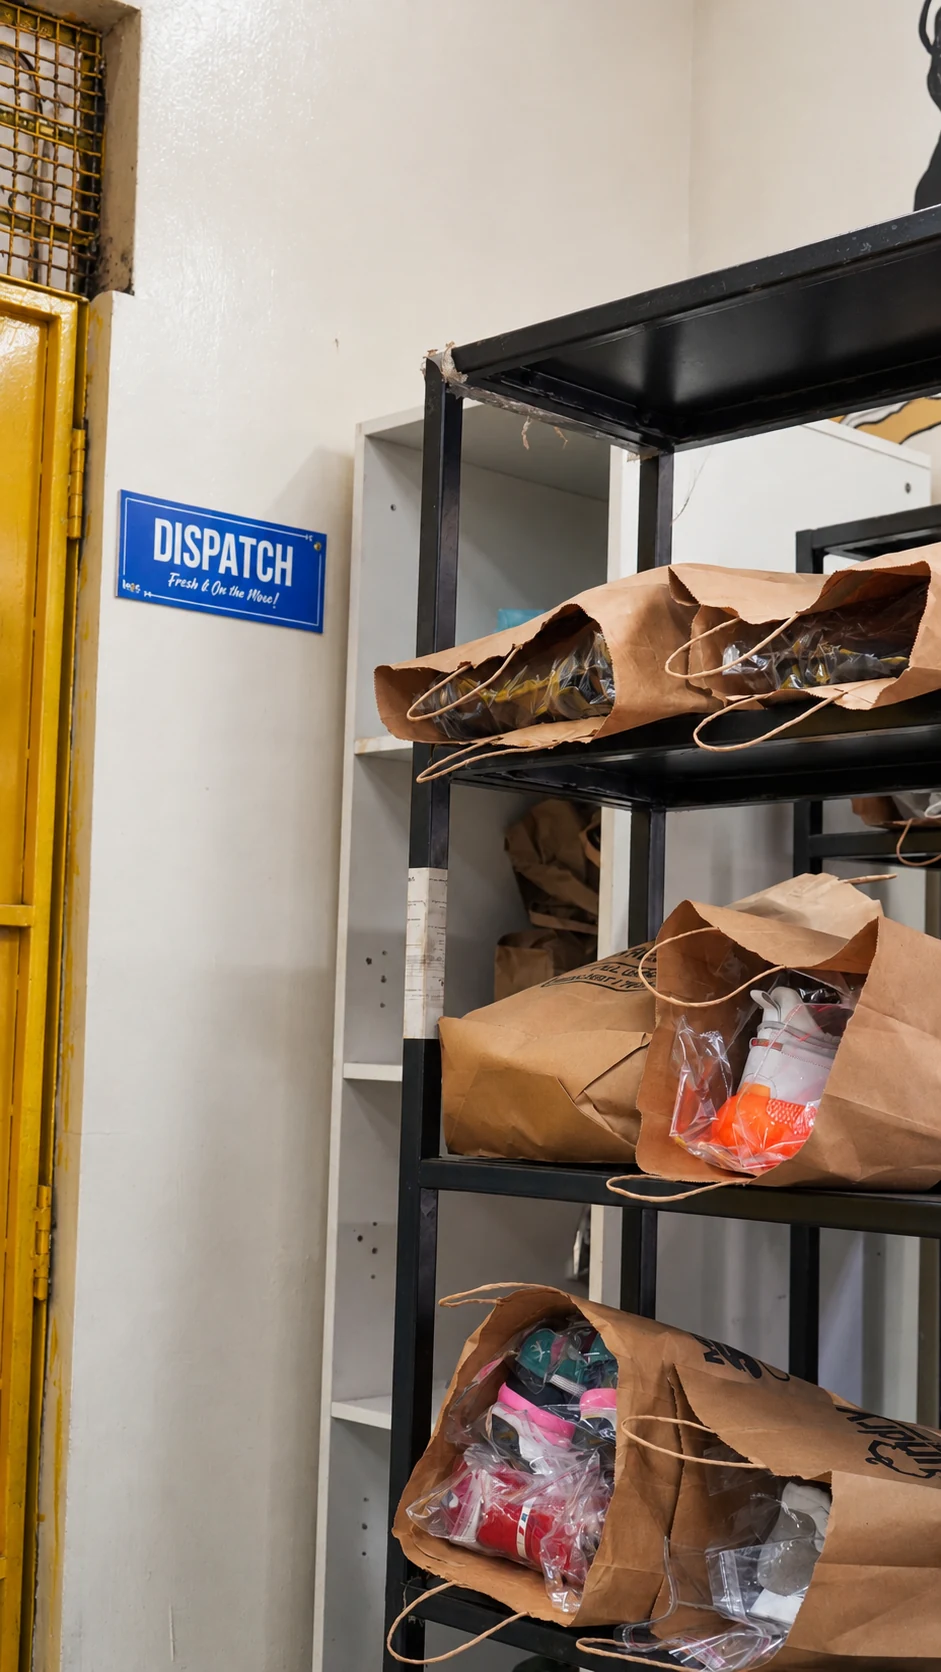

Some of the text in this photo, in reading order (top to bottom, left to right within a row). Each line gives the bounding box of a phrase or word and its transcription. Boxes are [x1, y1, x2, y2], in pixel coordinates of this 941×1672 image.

[153, 517, 294, 587] DISPATCH
[167, 572, 199, 590] Fresh
[201, 579, 210, 592] &
[211, 580, 227, 596] On
[229, 585, 245, 599] the
